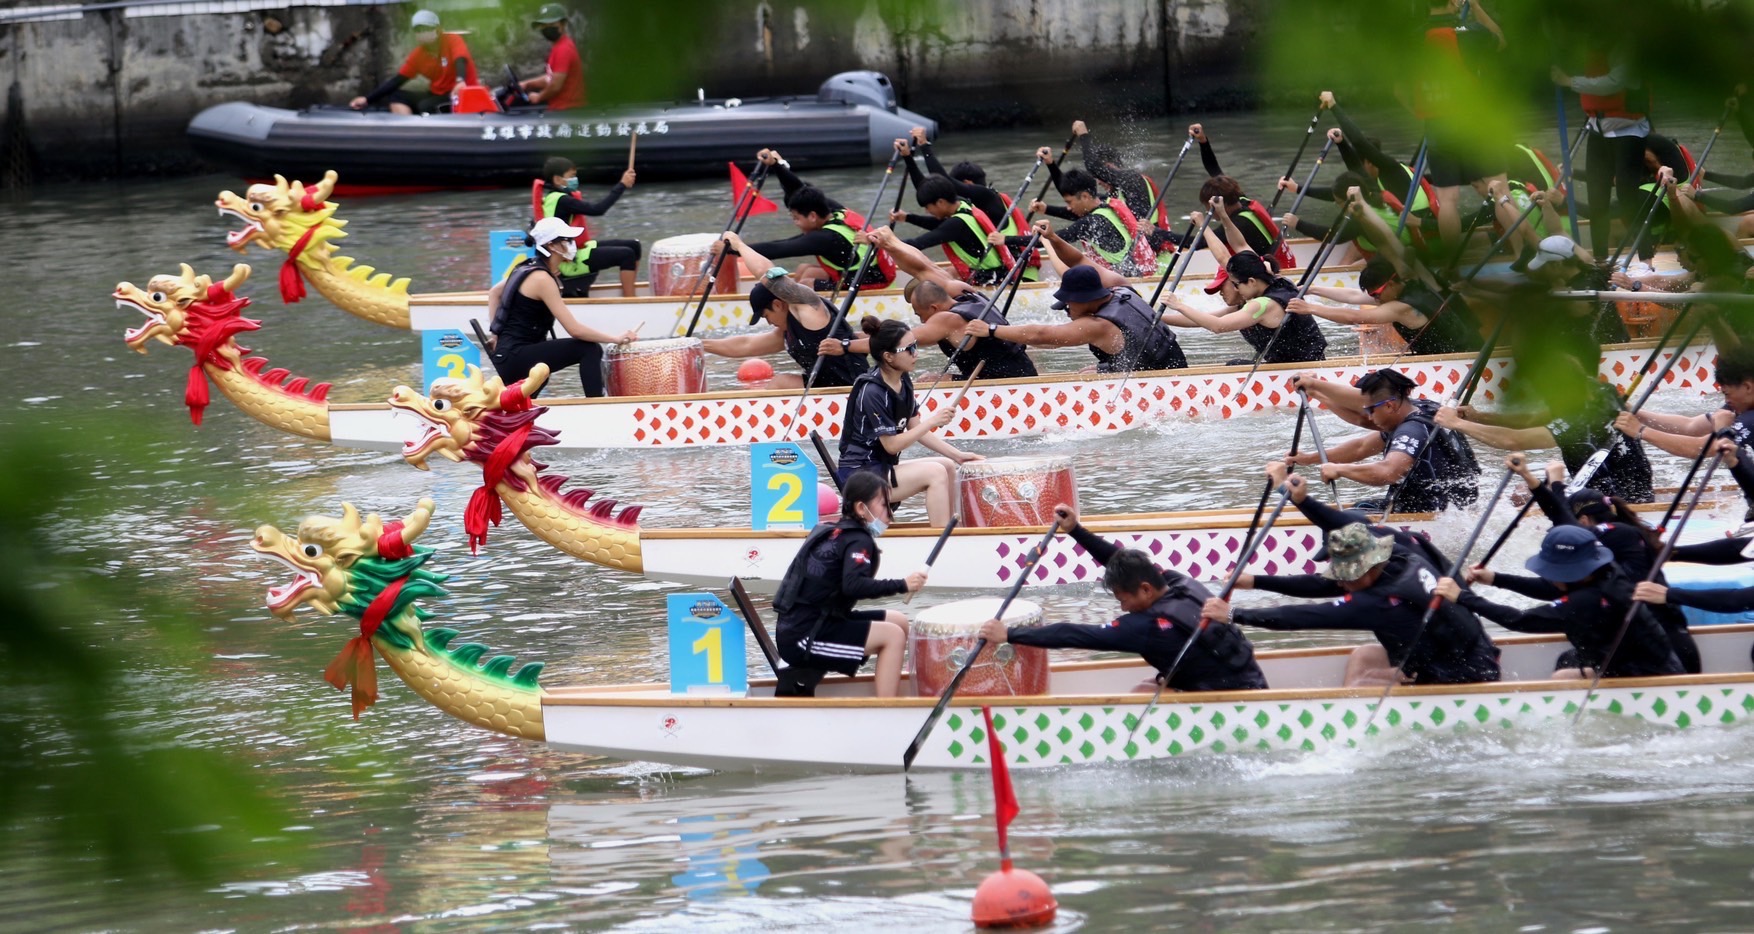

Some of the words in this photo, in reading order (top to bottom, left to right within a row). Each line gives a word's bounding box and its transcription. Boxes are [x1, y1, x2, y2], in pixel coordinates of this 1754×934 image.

[481, 121, 669, 141] 高雄市政府運動發展局
[767, 472, 804, 522] 2
[693, 627, 723, 683] 1
